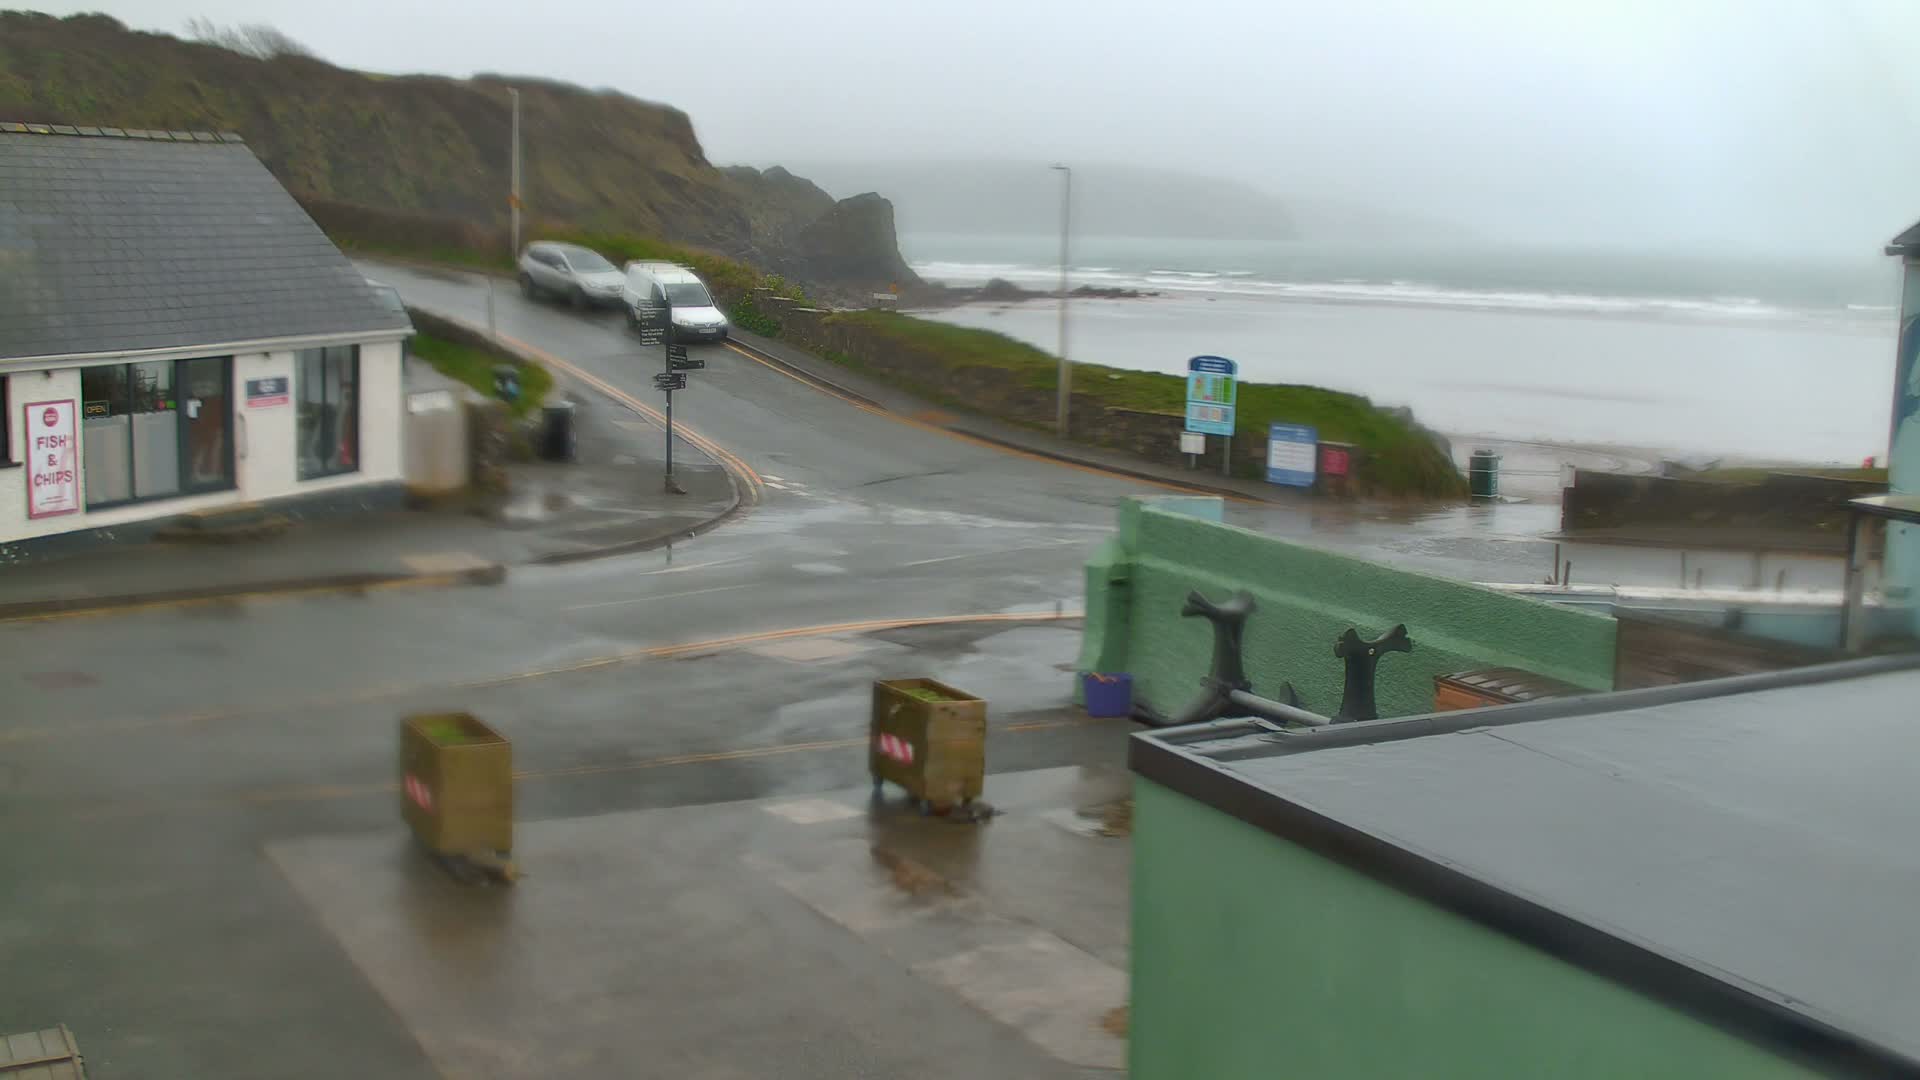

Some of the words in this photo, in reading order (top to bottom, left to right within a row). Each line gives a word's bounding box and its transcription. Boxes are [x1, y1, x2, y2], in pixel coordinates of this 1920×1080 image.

[36, 434, 67, 450] FISH
[47, 454, 57, 467] &
[34, 470, 73, 487] CHIPS
